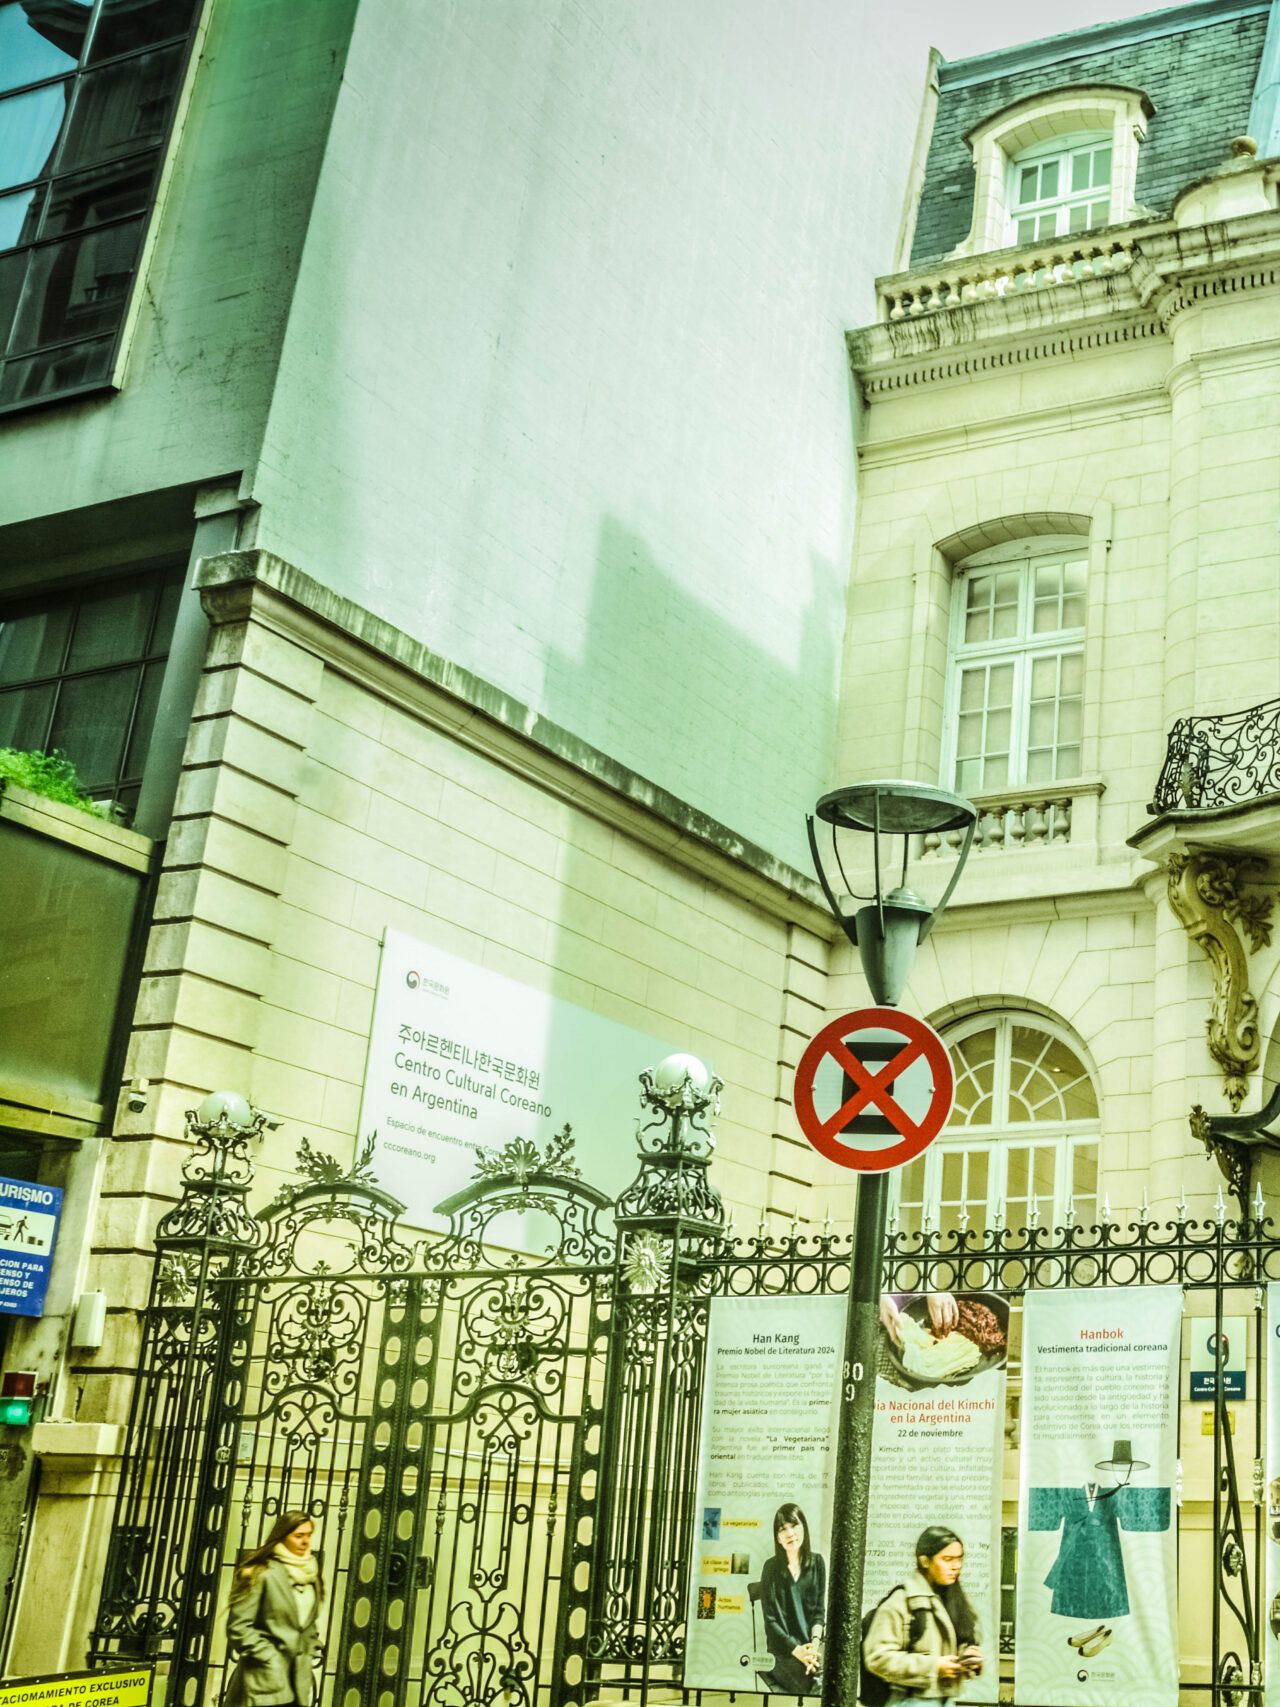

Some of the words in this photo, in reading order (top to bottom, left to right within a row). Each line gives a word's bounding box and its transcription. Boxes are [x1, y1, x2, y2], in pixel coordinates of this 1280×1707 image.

[398, 1024, 540, 1090] 주아르헨티나한국문화원
[394, 1051, 441, 1081] Centro
[445, 1069, 497, 1099] Cultural
[500, 1088, 552, 1118] Coreano
[390, 1081, 408, 1098] en
[412, 1085, 478, 1120] Argentina
[386, 1116, 415, 1132] Espacio
[417, 1126, 426, 1135] de
[428, 1130, 463, 1146] encuentro
[383, 1141, 436, 1164] cccoreano.org
[0, 1183, 53, 1205] URISMO
[22, 1263, 43, 1272] PARA
[23, 1281, 34, 1289] DE
[1080, 1328, 1123, 1339] Hanbok
[753, 1334, 771, 1343] Han
[775, 1334, 800, 1345] Kang
[1037, 1345, 1084, 1354] Vestimenta
[1086, 1344, 1131, 1352] tradicional
[1133, 1343, 1167, 1351] coreana
[889, 1400, 935, 1410] Nacional
[938, 1399, 954, 1410] del
[958, 1399, 995, 1410] Kimchi
[890, 1415, 903, 1423] en
[906, 1414, 915, 1423] la
[919, 1413, 971, 1425] Argentina
[909, 1429, 919, 1437] de
[921, 1429, 963, 1437] noviembre
[979, 1541, 990, 1550] ley
[90, 1678, 145, 1693] EXCLUSIVO
[85, 1696, 119, 1707] COREA
